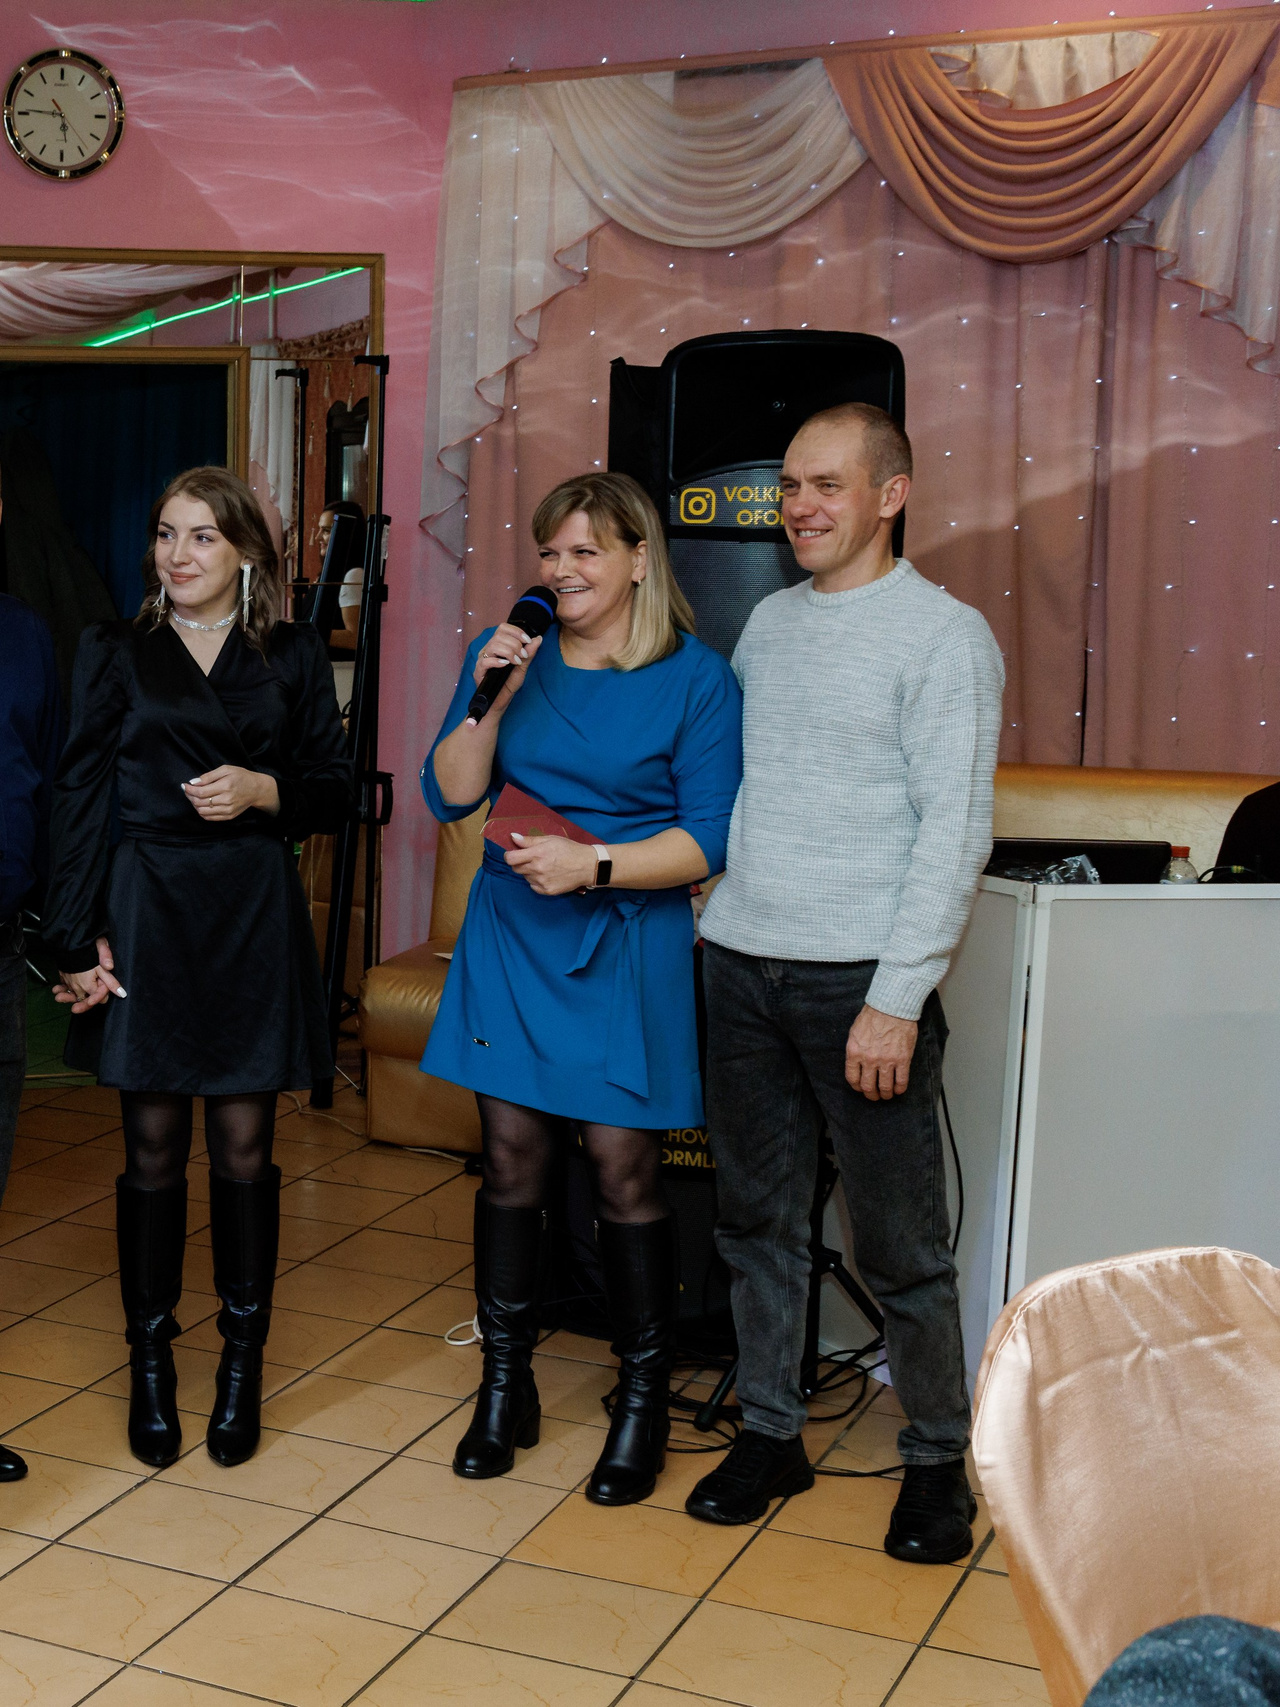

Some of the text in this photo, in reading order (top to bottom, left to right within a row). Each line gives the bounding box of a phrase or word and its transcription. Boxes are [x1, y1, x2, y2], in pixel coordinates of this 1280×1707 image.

[736, 509, 784, 525] OFO
[663, 1128, 709, 1145] HOV
[661, 1148, 717, 1168] ORML
